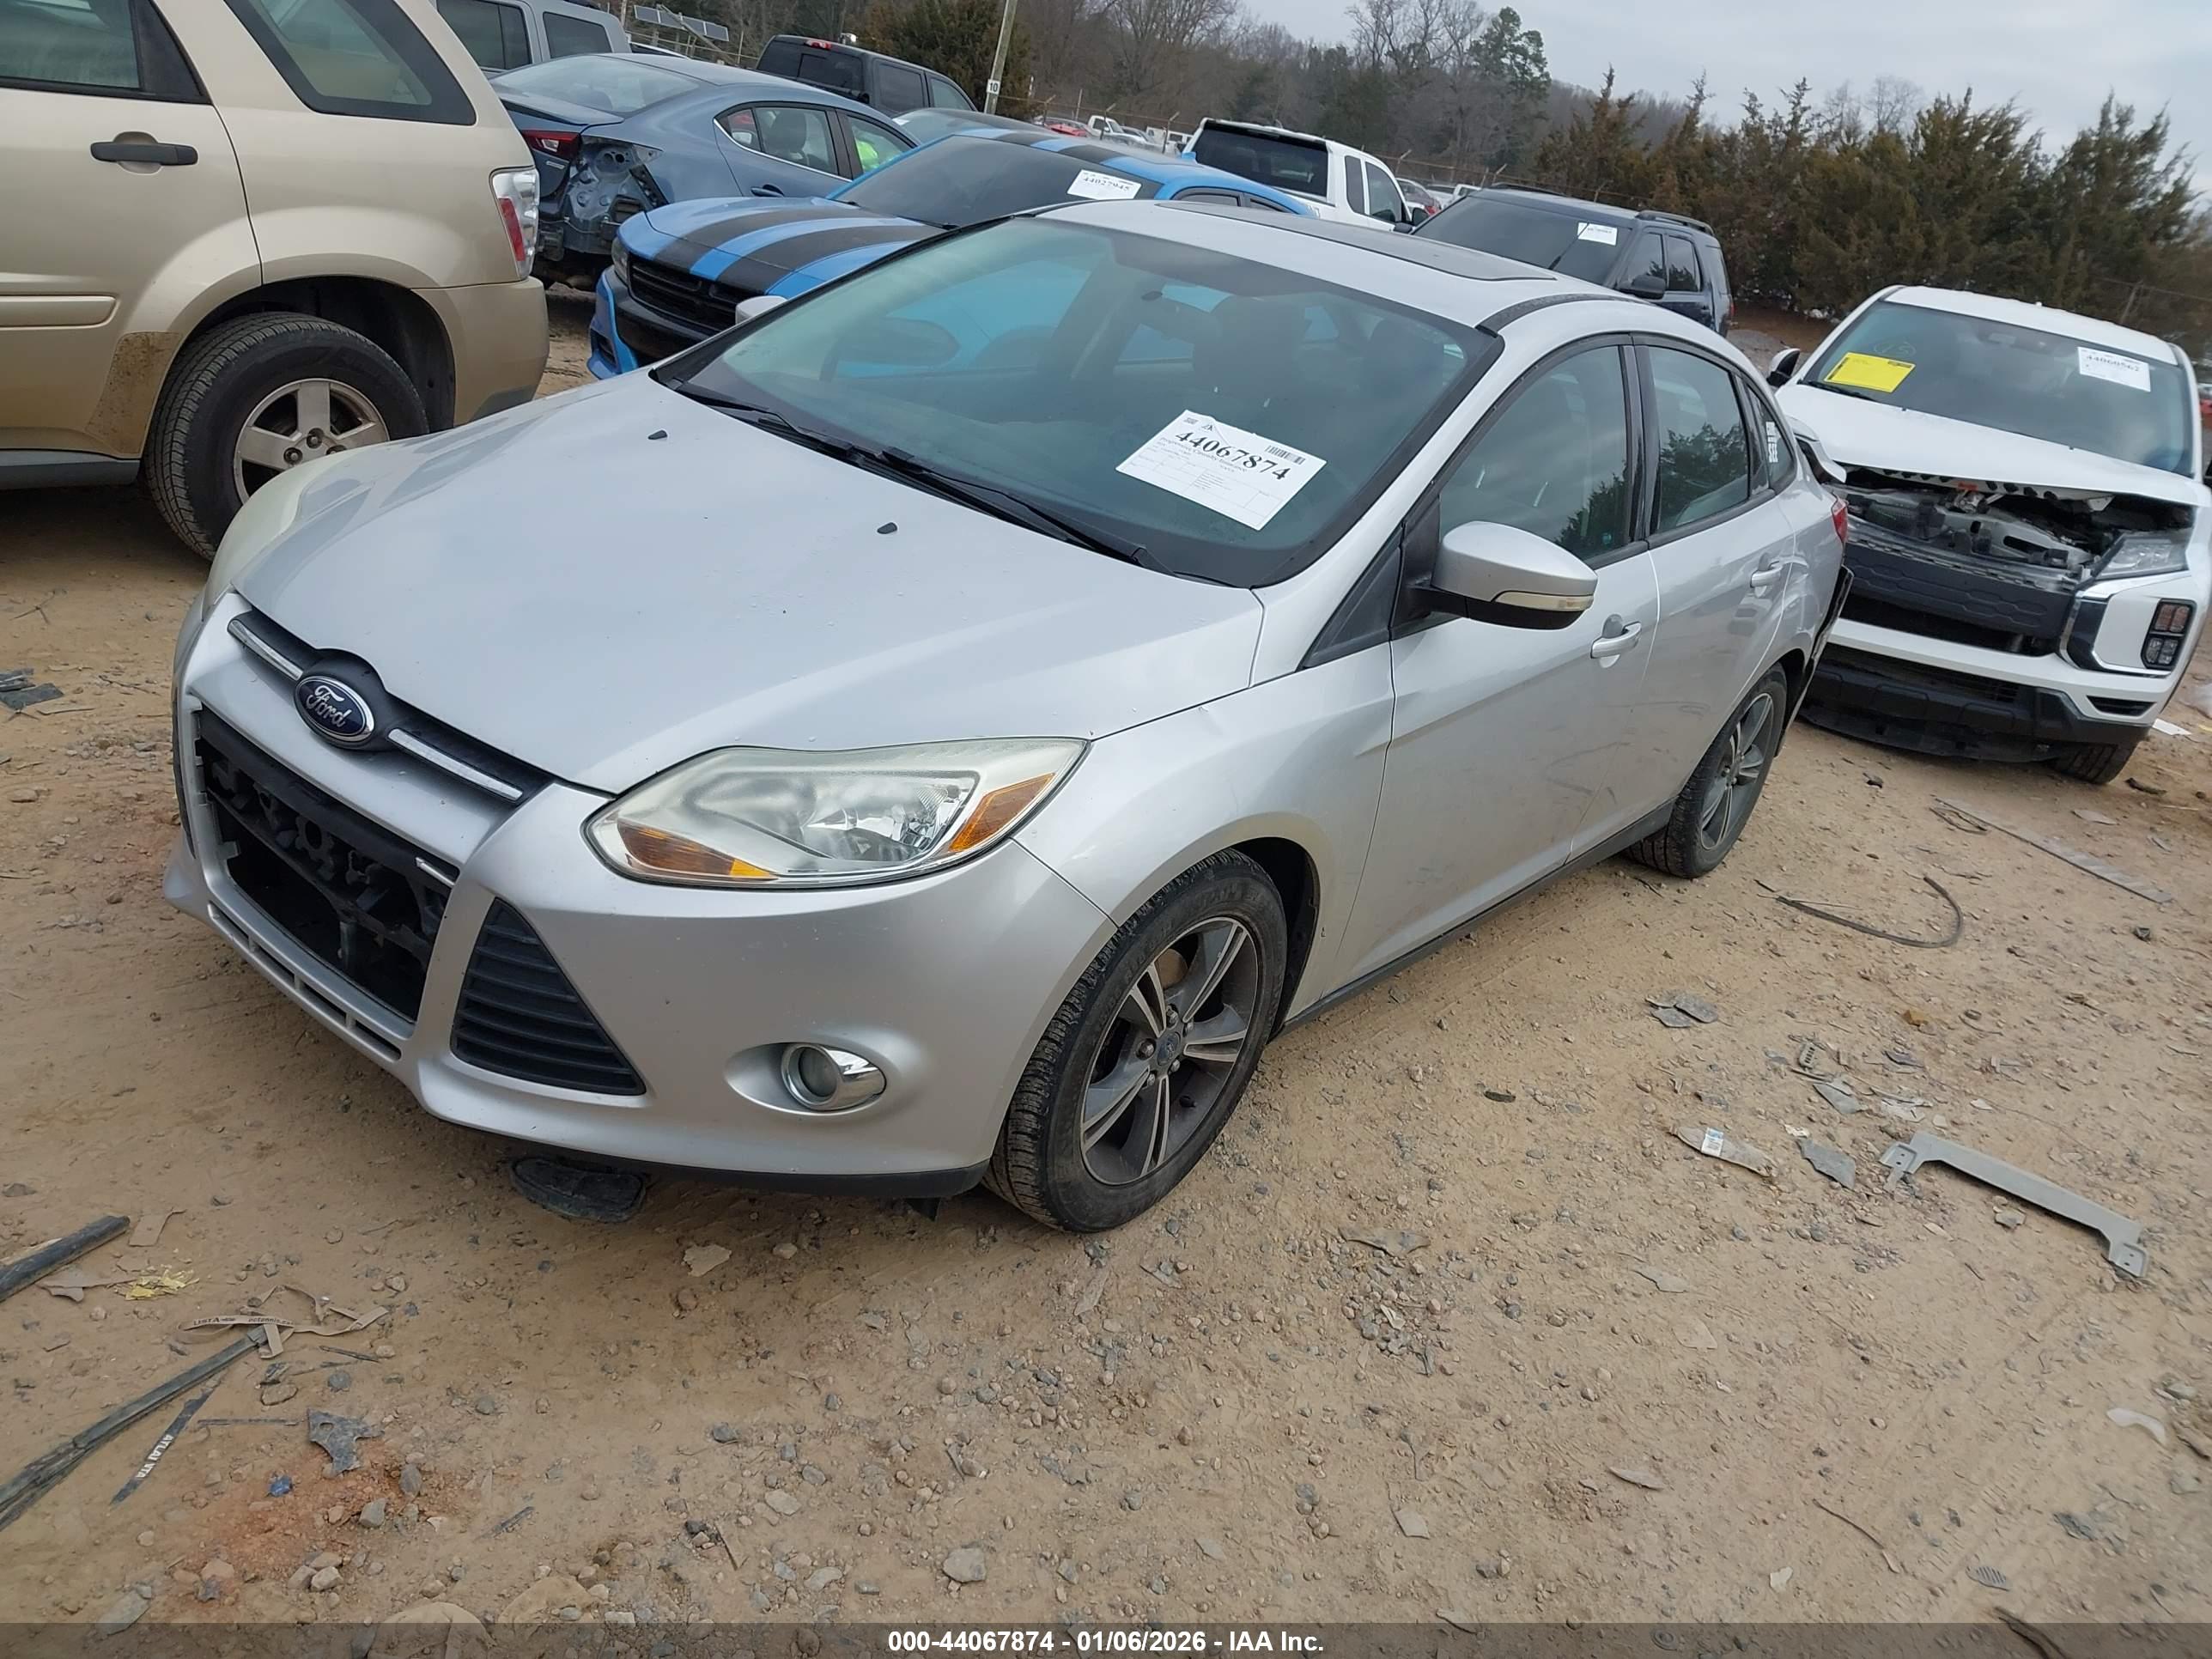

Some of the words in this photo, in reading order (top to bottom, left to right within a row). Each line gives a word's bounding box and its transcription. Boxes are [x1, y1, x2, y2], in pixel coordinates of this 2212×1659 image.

[990, 82, 999, 93] 10
[1176, 431, 1291, 480] 44067874
[306, 684, 352, 728] Ford
